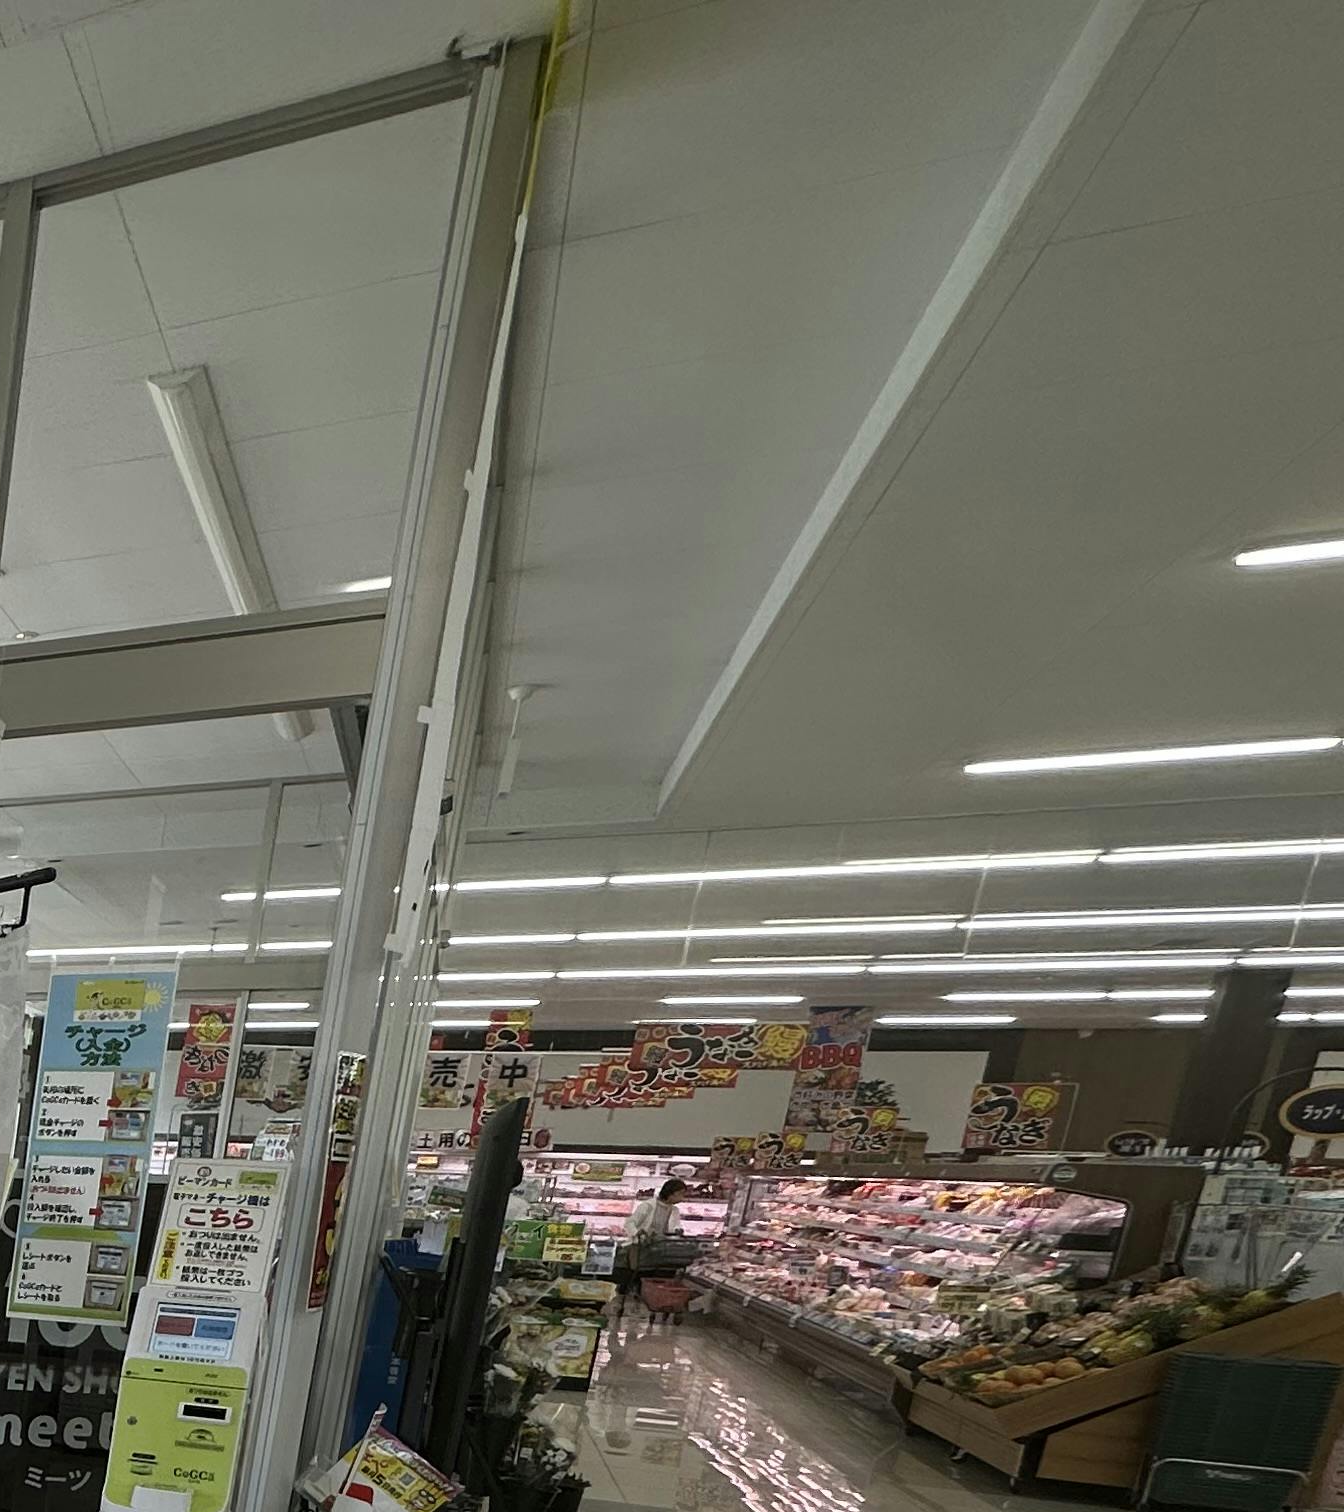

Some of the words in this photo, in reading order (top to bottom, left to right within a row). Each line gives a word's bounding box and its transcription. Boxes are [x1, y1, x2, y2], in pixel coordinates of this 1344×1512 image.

[64, 1023, 147, 1038] チャージ
[80, 1053, 123, 1067] 方法
[801, 1043, 862, 1069] BBQ
[429, 1056, 461, 1088] 売
[498, 1058, 528, 1088] 中
[184, 1208, 254, 1230] こちら
[24, 1466, 93, 1491] ミーツ
